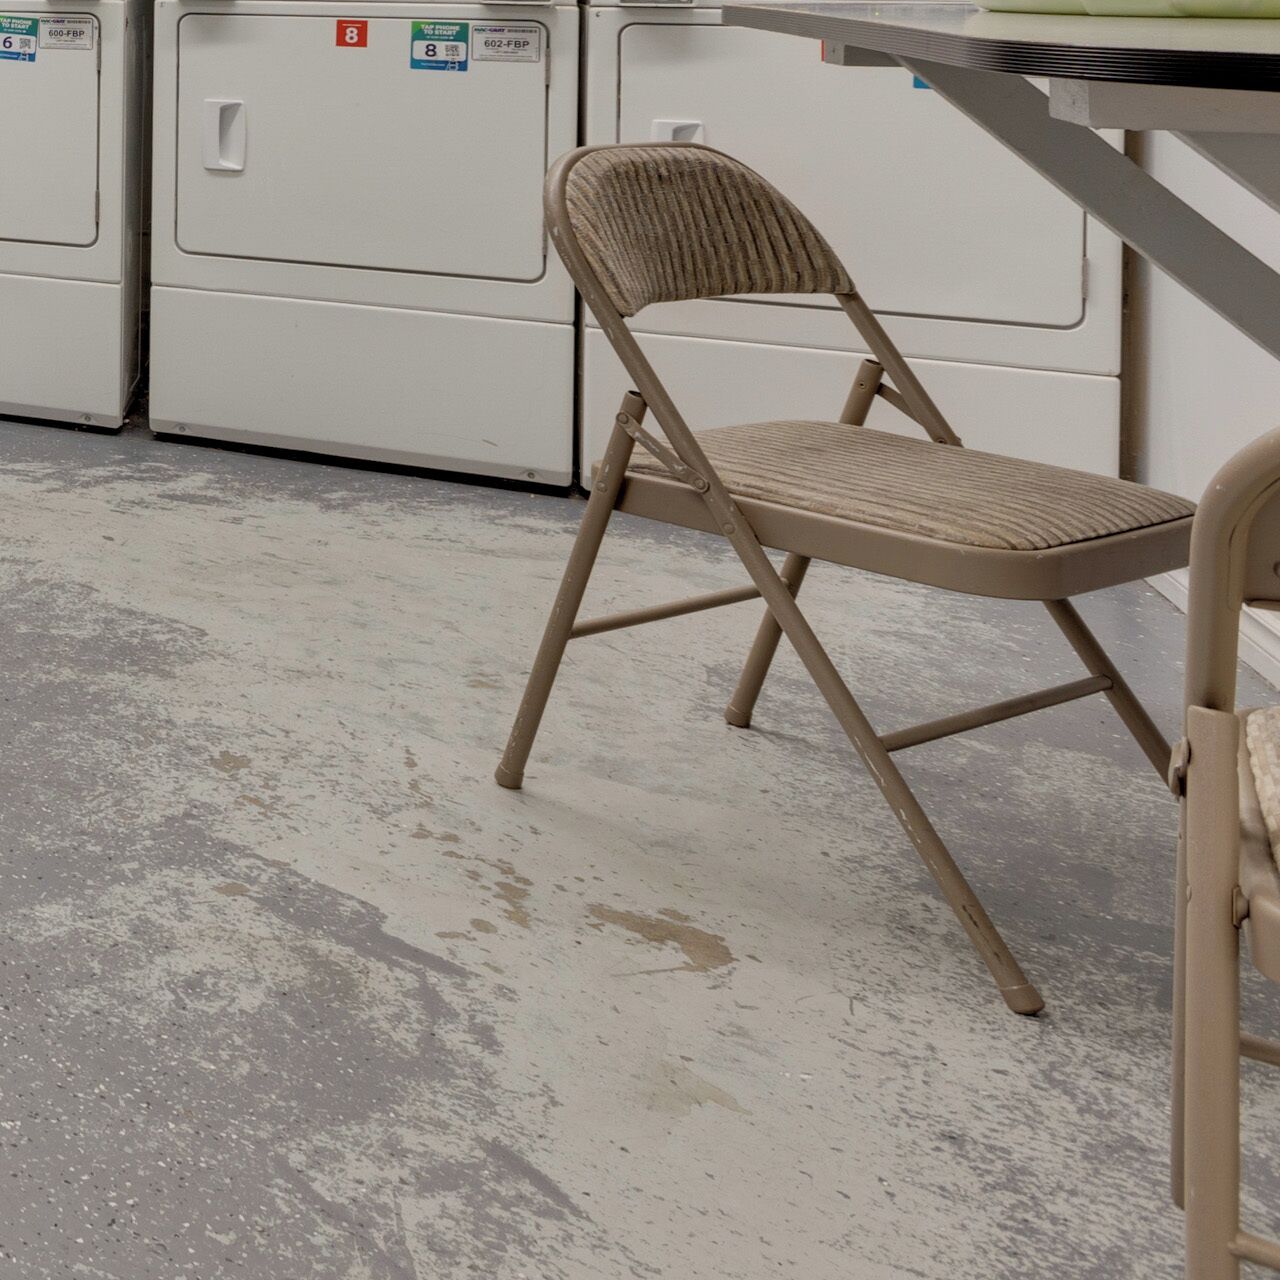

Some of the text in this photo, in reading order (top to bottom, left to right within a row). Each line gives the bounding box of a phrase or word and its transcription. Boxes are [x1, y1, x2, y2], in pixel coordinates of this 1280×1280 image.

[345, 27, 358, 43] 8
[3, 37, 13, 48] 6
[485, 40, 529, 49] 602-FBP
[425, 44, 437, 57] 8
